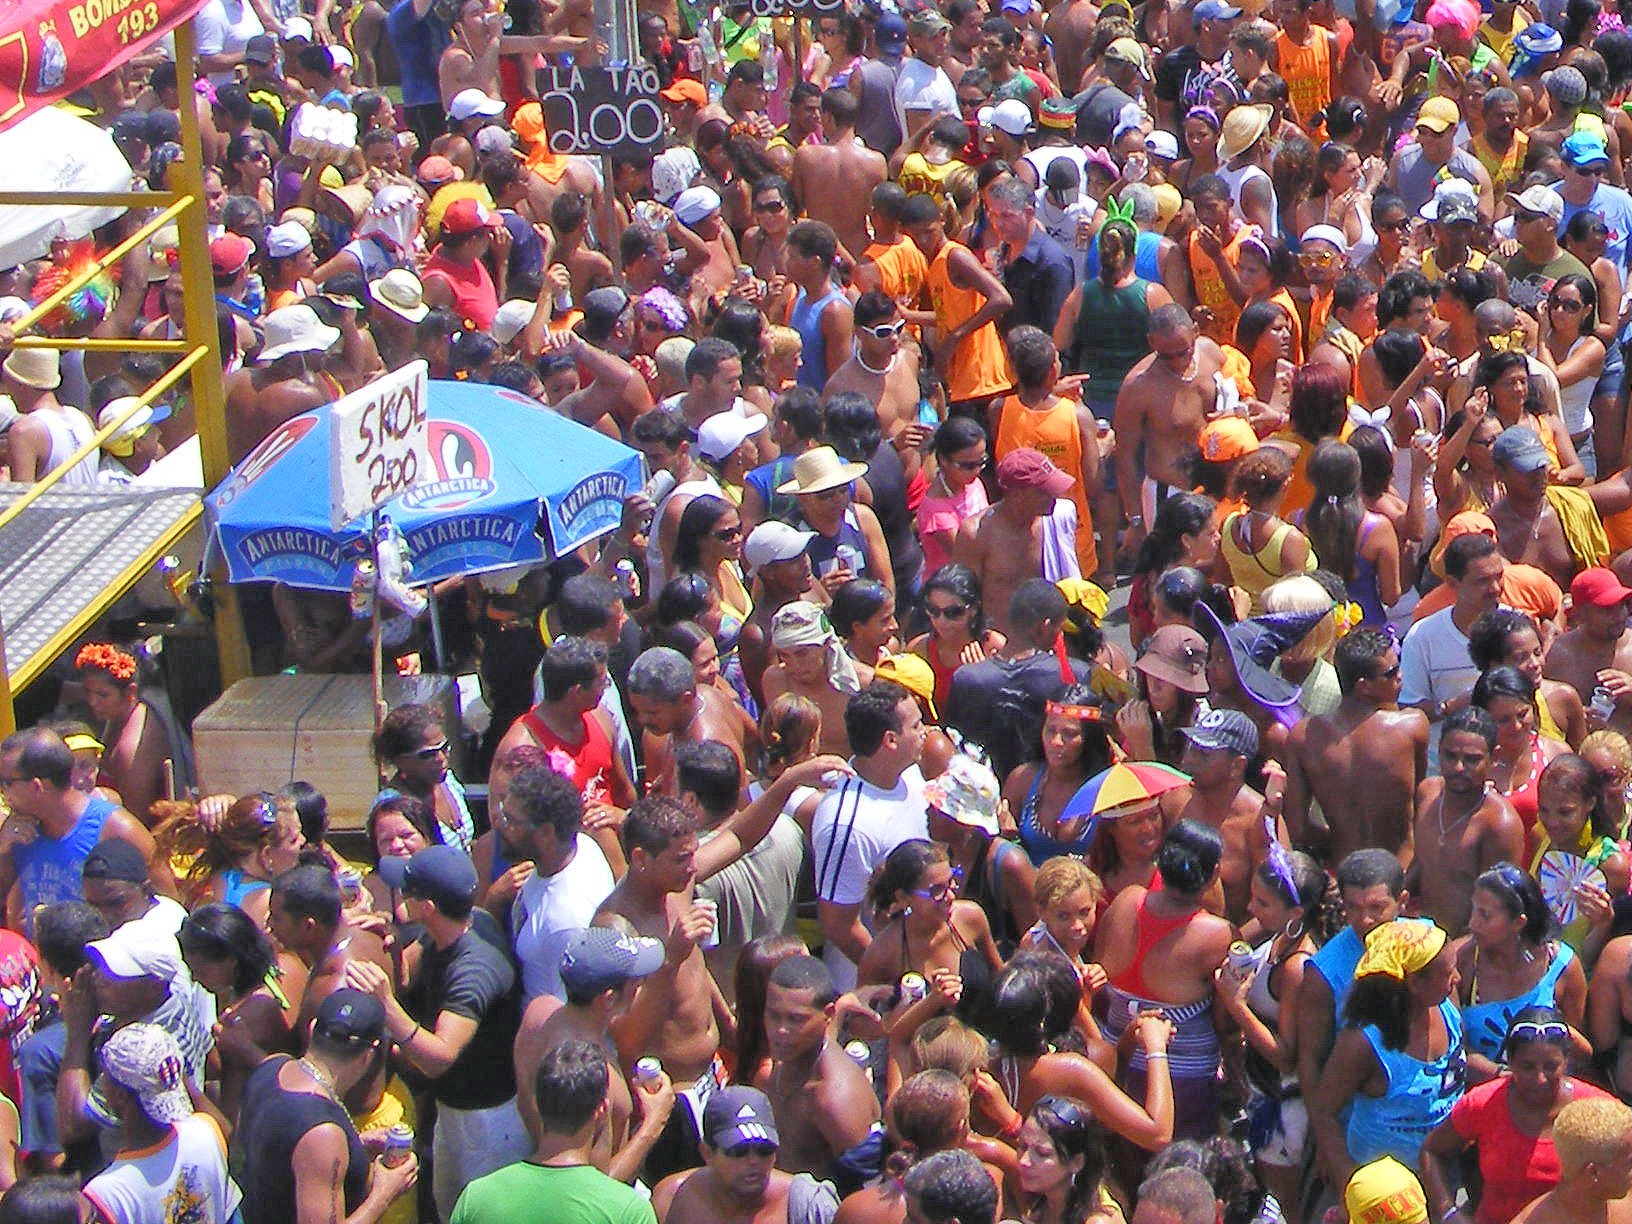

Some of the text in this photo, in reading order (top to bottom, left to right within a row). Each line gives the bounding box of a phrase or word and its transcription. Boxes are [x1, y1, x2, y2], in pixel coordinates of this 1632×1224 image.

[116, 1, 160, 45] 193
[552, 64, 585, 93] LA
[542, 89, 664, 154] 2.00
[405, 478, 489, 507] ANTARCTICA
[561, 474, 626, 526] ANTARCTICA
[248, 529, 341, 564] ANTARCTICA
